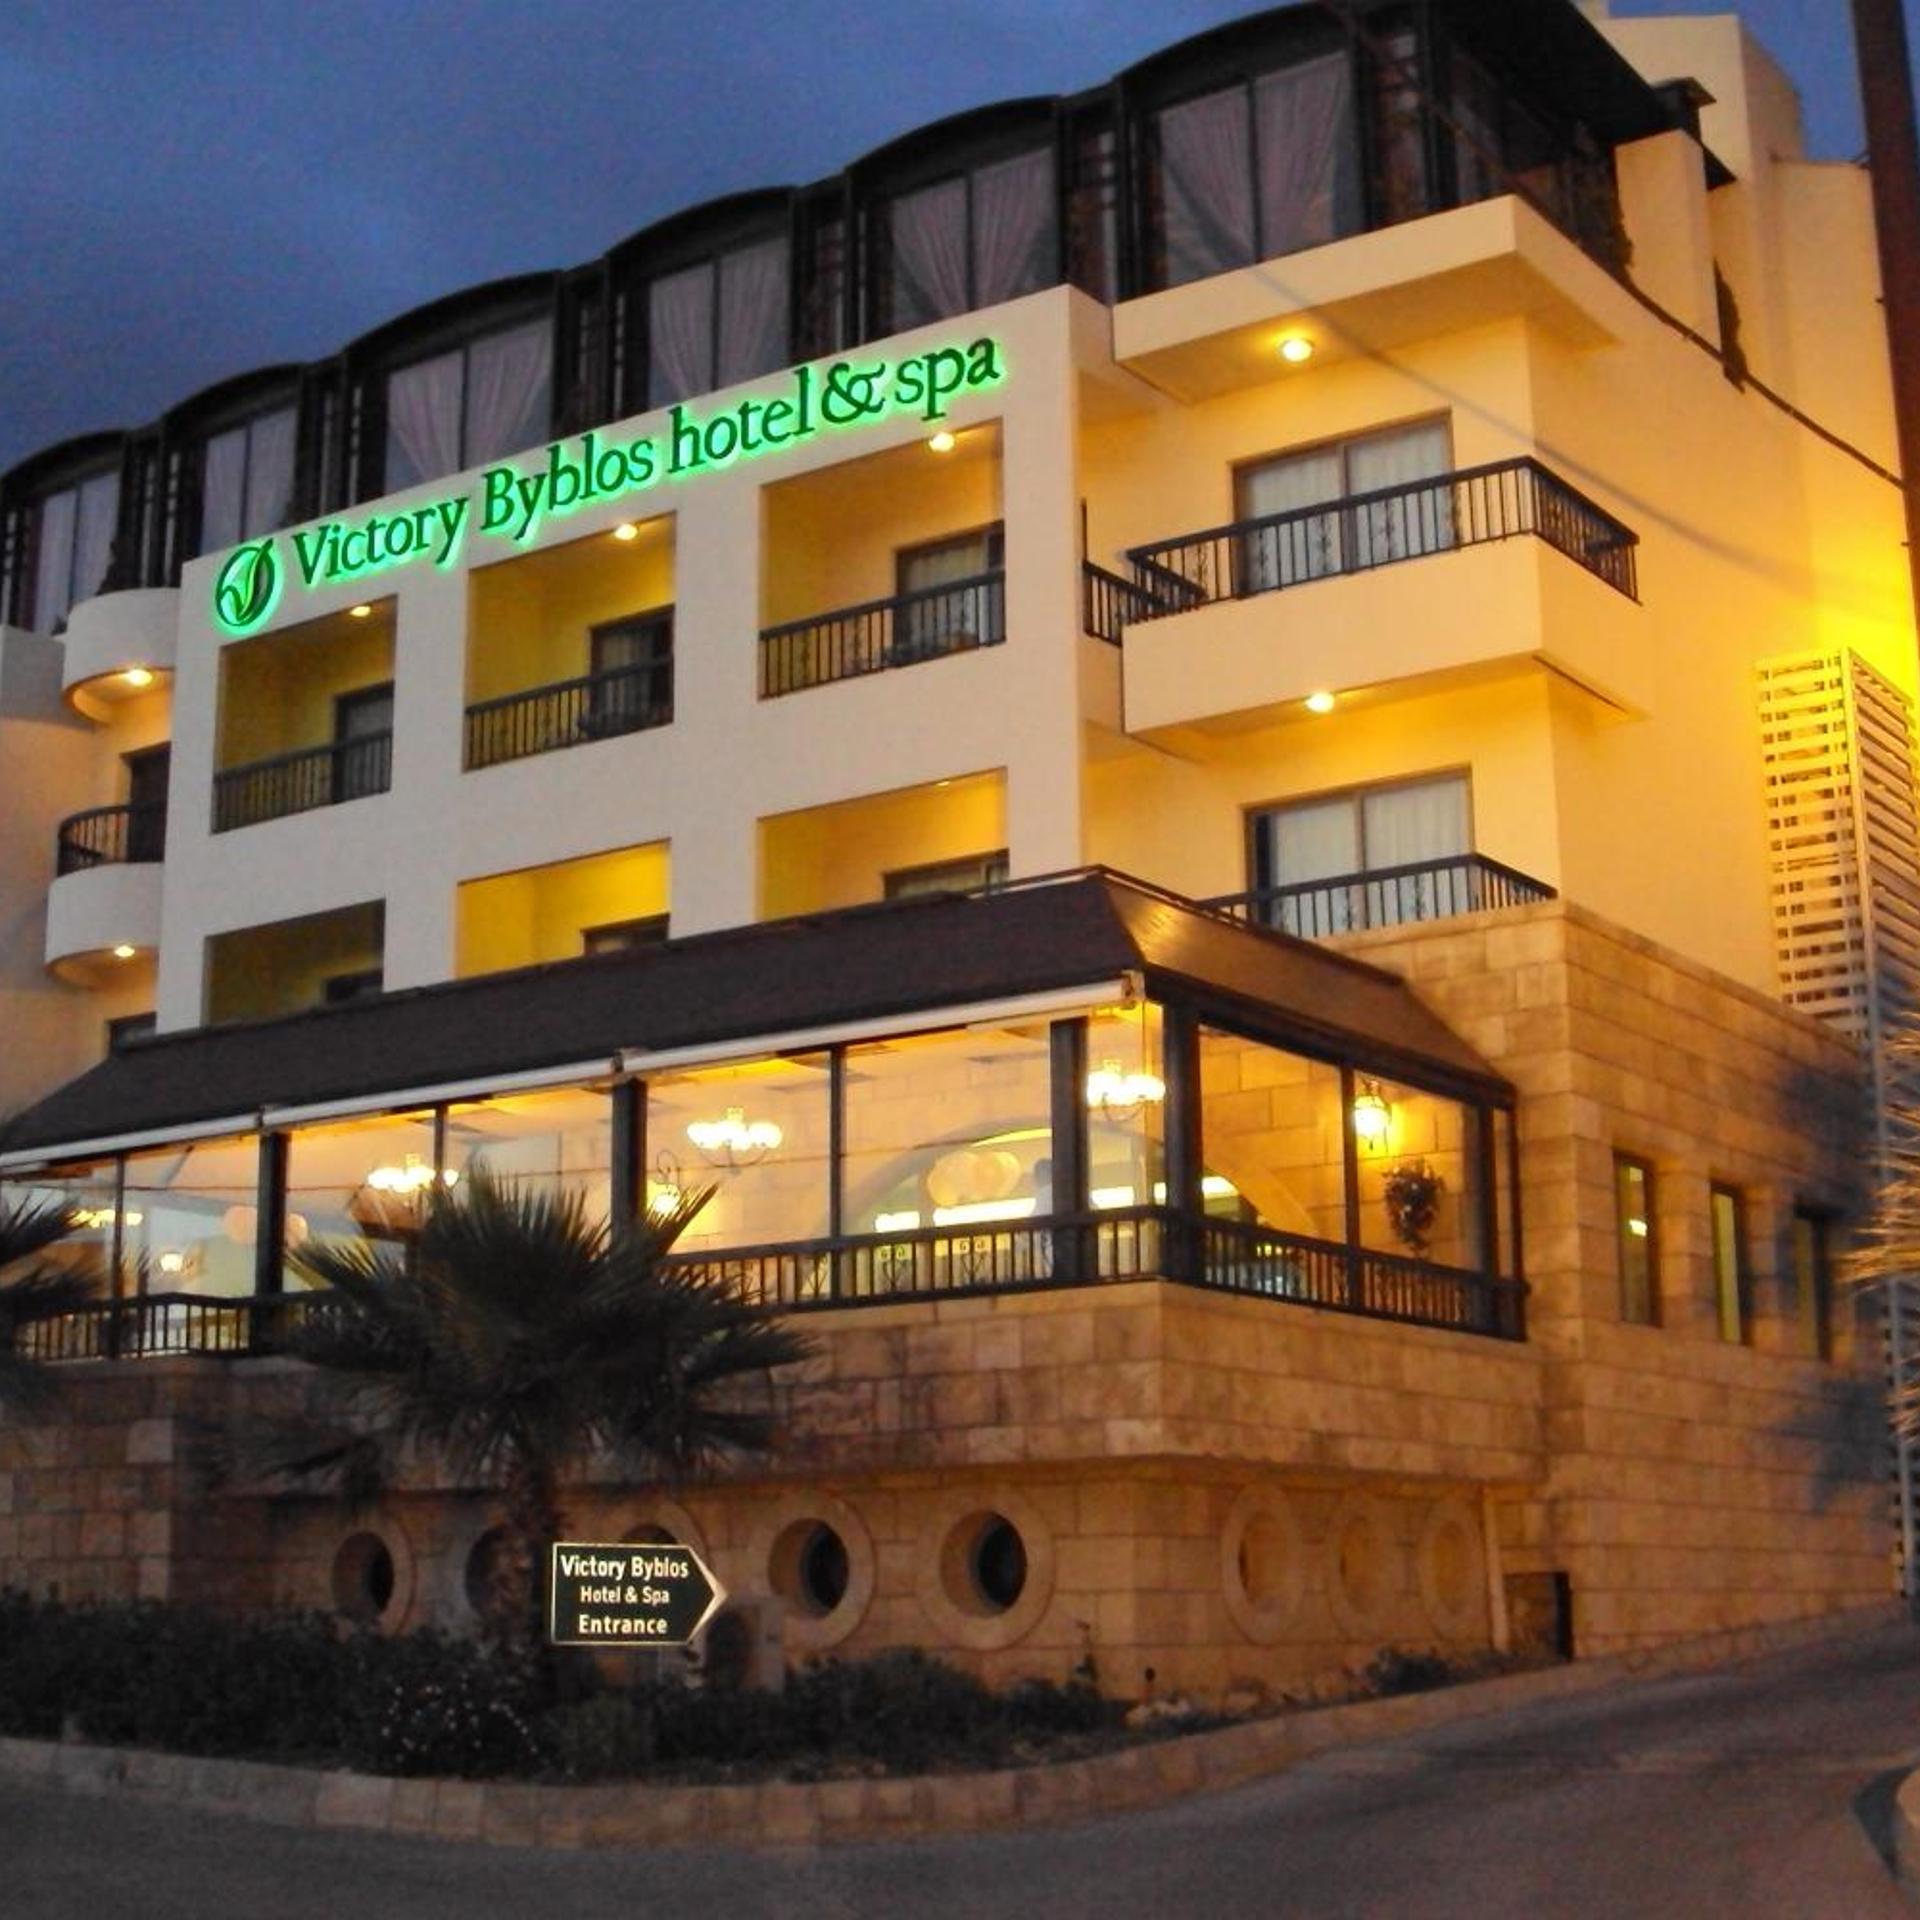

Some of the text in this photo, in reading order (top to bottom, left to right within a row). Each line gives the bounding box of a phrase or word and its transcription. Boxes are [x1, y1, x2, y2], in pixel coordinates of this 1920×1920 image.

[292, 497, 470, 585] Victory
[480, 432, 655, 541] Byblos
[894, 337, 1001, 422] spa
[560, 1554, 689, 1581] Victory Byblos
[580, 1585, 671, 1607] Hotel & Spa
[578, 1614, 668, 1635] Entrance
